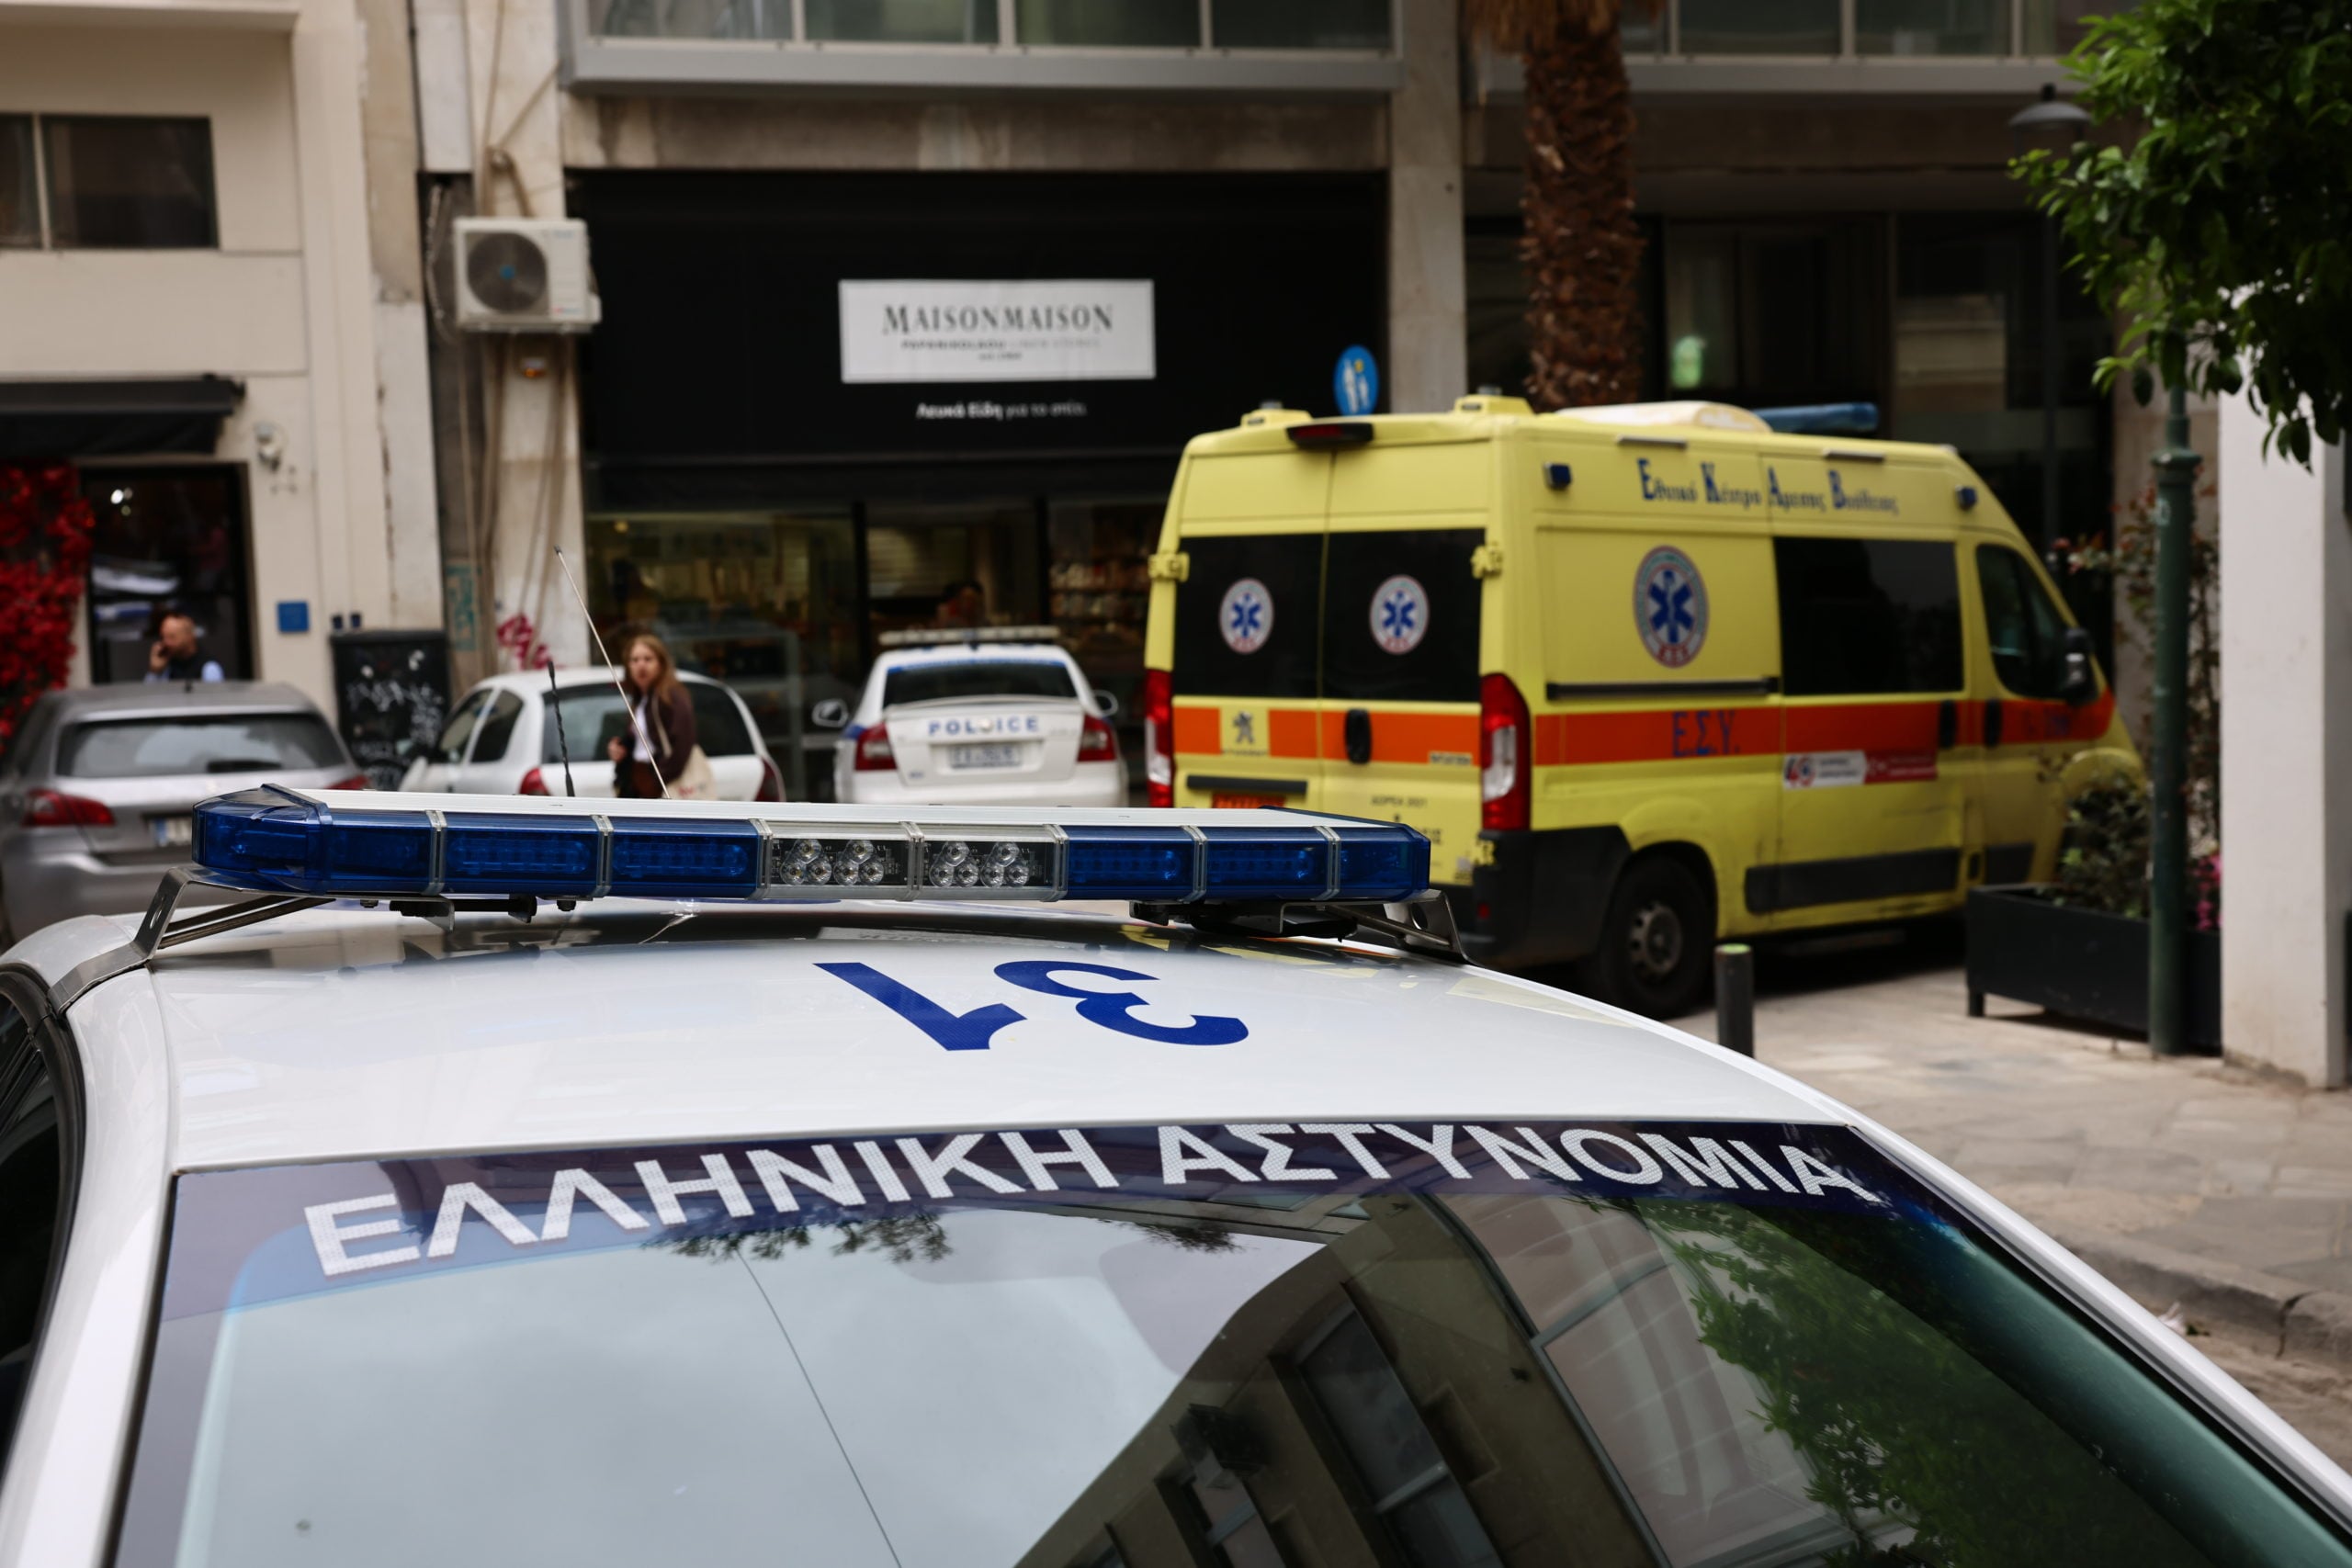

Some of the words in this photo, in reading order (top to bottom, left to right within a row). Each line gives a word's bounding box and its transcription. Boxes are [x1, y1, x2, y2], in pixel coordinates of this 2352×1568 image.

[928, 715, 1039, 736] POLICE
[811, 960, 1250, 1052] 31
[303, 1128, 1120, 1276] ΕΛΛΗΝΙΚΗ
[1157, 1122, 1883, 1203] ΑΣΤΥΝΟΜΙΑ
